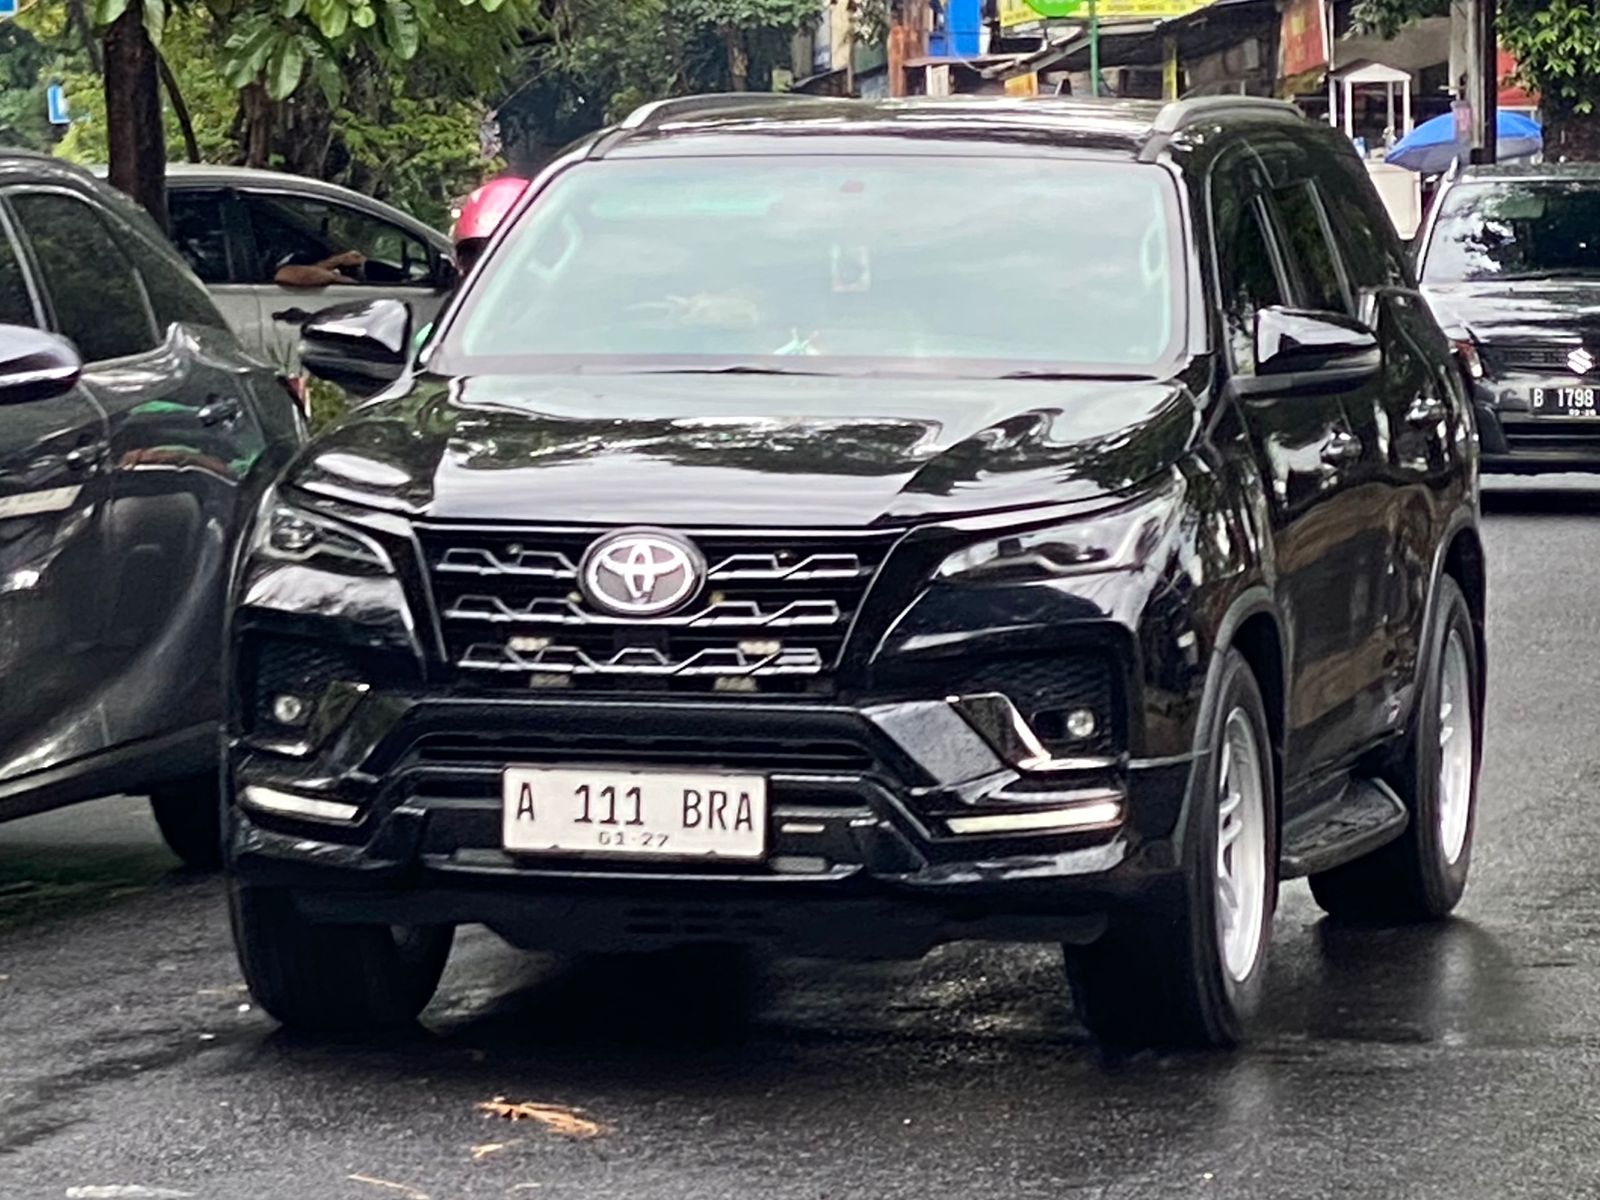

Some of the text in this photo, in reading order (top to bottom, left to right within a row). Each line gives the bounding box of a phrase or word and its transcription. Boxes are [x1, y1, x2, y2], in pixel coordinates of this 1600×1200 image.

[1533, 388, 1594, 408] B 1798
[516, 782, 753, 832] A 111 BRA
